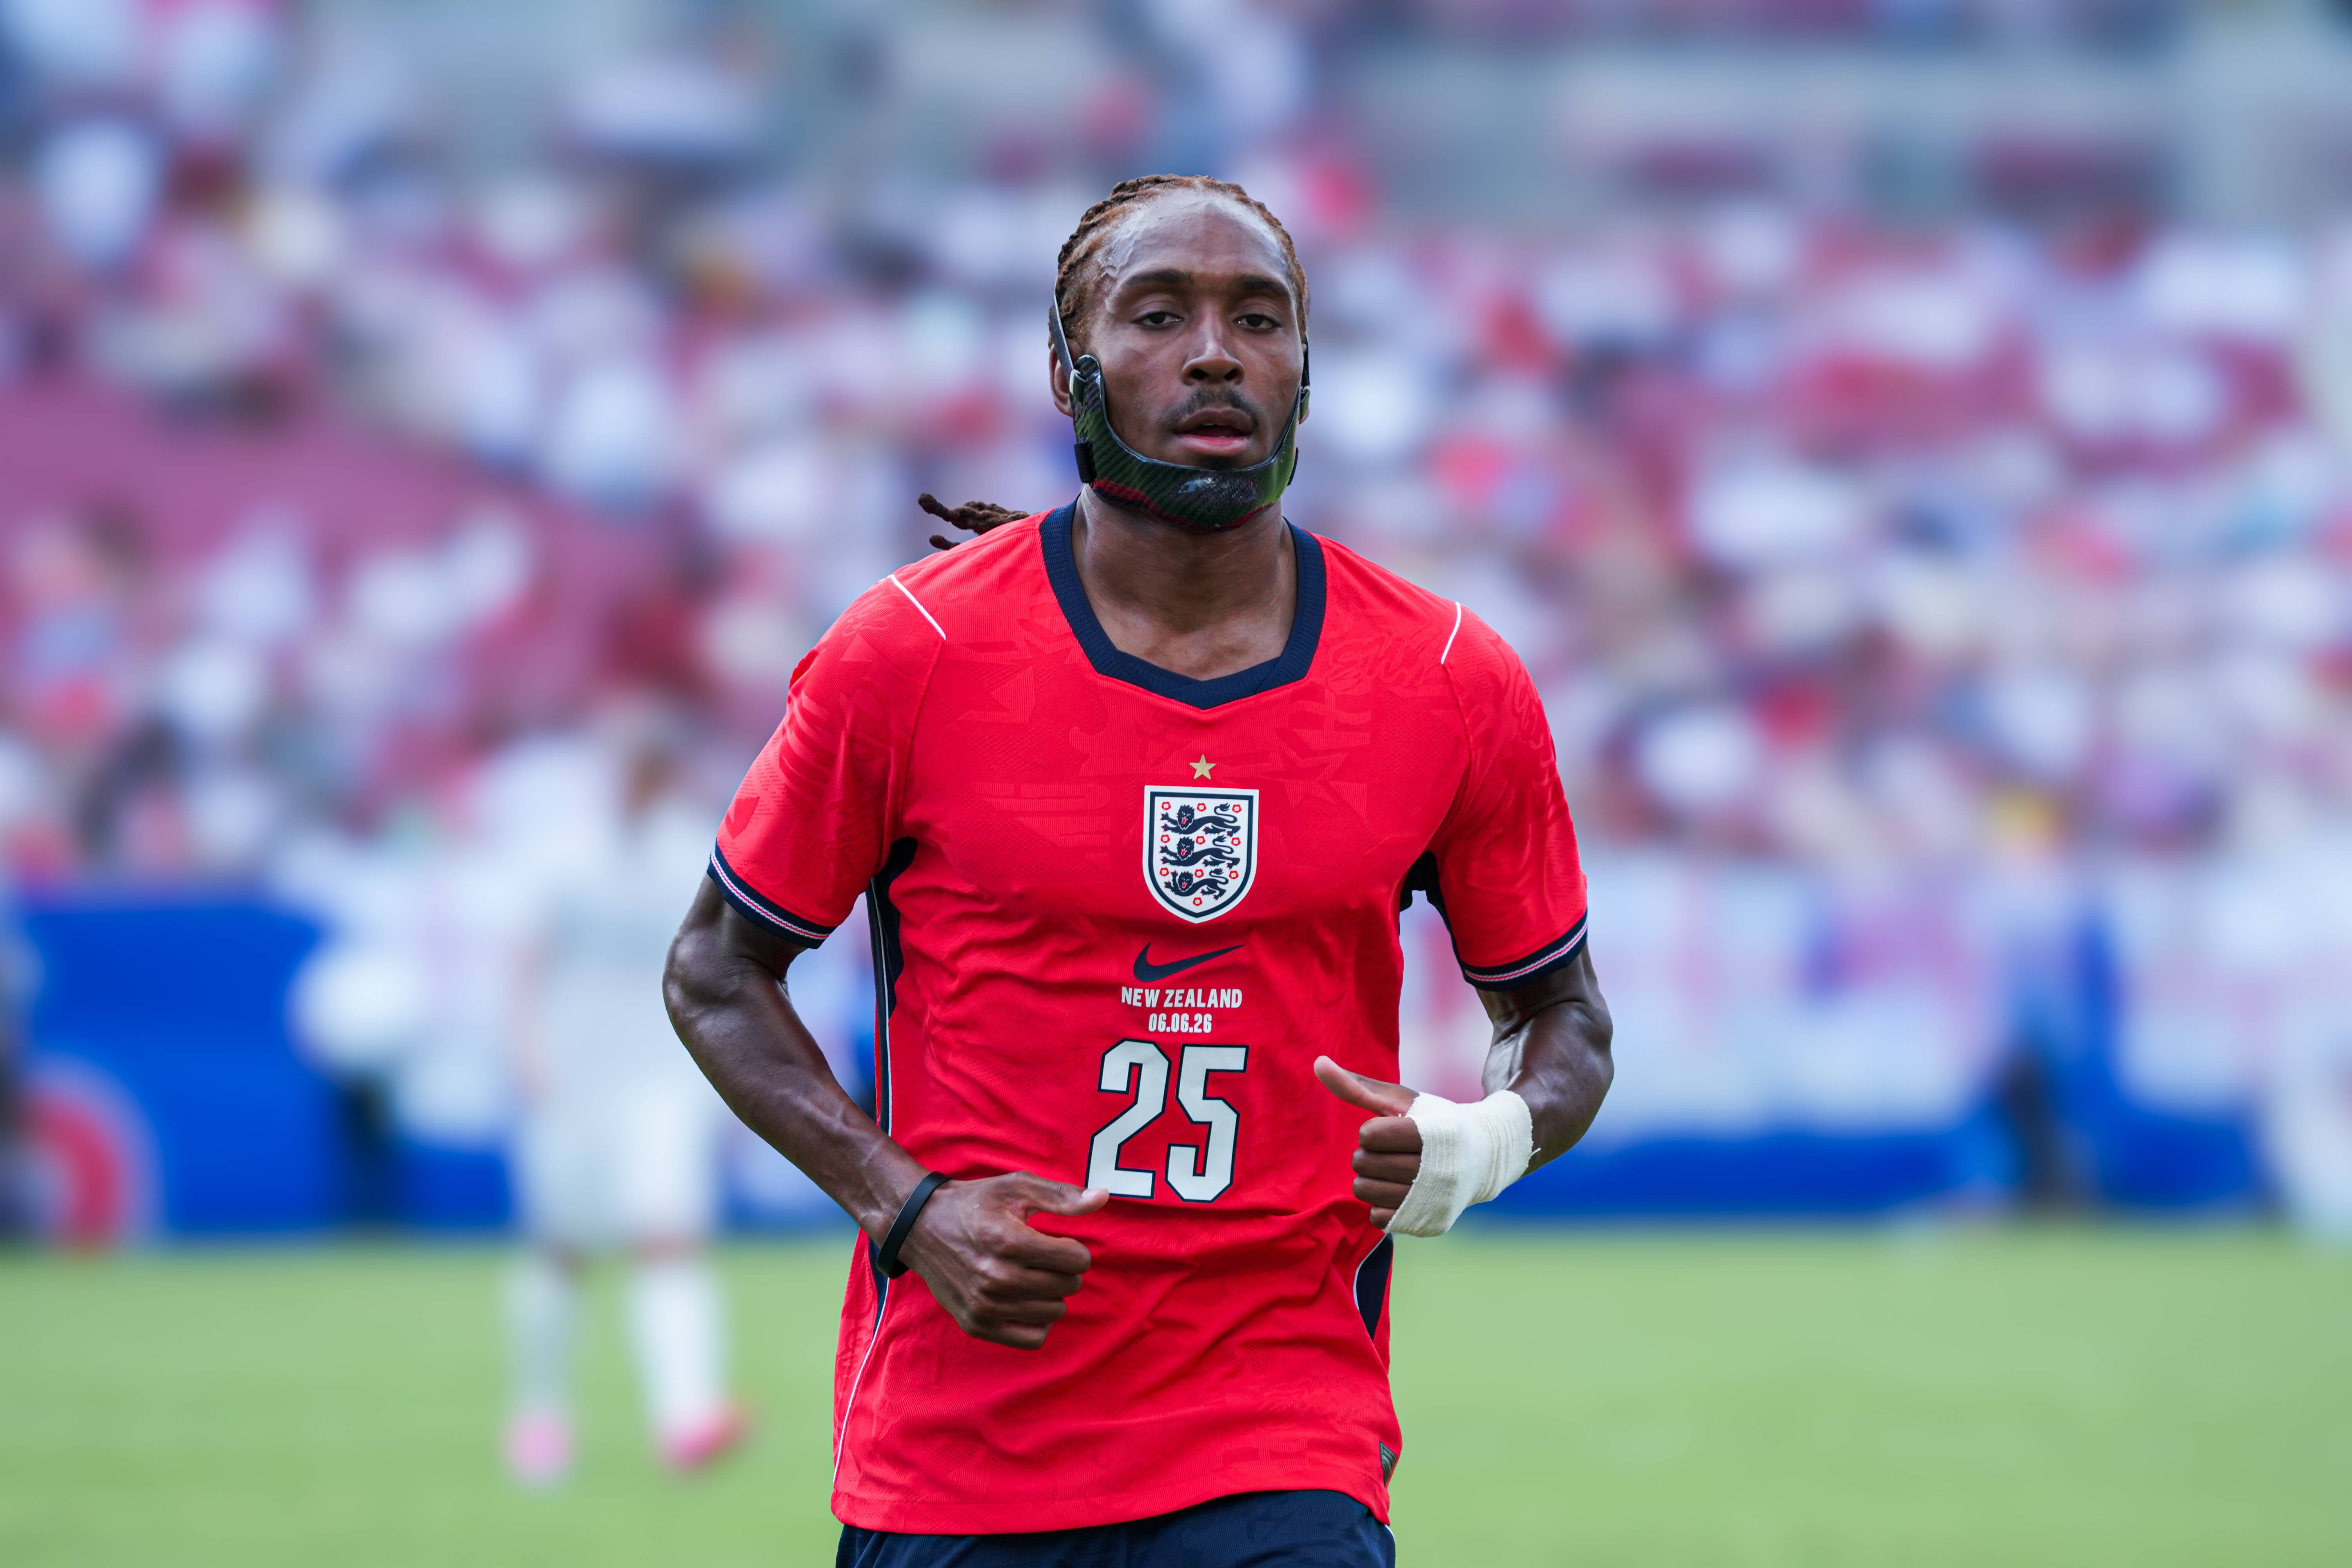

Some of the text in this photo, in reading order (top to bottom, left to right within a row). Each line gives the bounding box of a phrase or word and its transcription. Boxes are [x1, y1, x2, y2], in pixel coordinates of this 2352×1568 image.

[1121, 986, 1243, 1008] NEW ZEALAND
[1148, 1013, 1212, 1033] 06.06.26
[1085, 1038, 1249, 1203] 25
